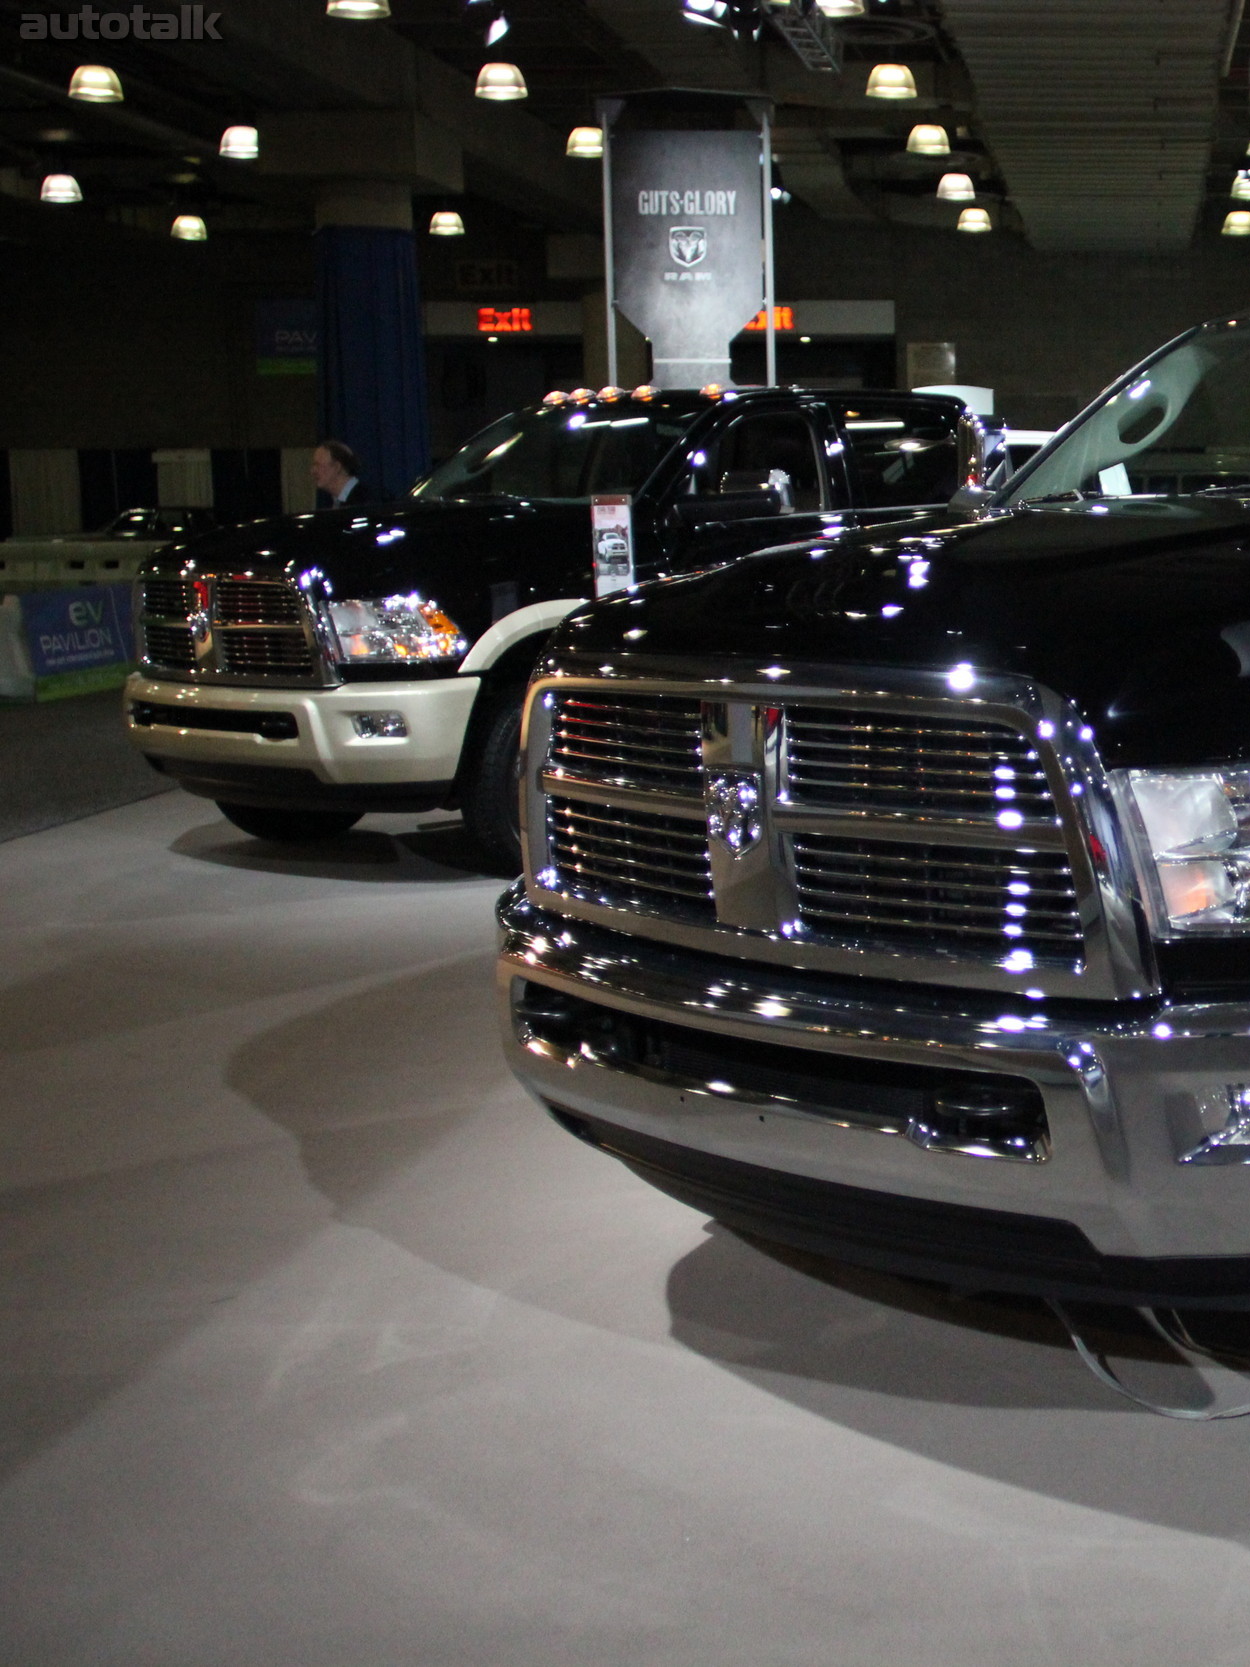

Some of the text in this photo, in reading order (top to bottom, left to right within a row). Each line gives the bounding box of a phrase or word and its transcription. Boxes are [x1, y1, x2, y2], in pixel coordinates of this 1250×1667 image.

[664, 271, 712, 281] RAM
[478, 307, 533, 332] Exit
[743, 306, 794, 330] xit
[40, 628, 112, 656] PAVILION
